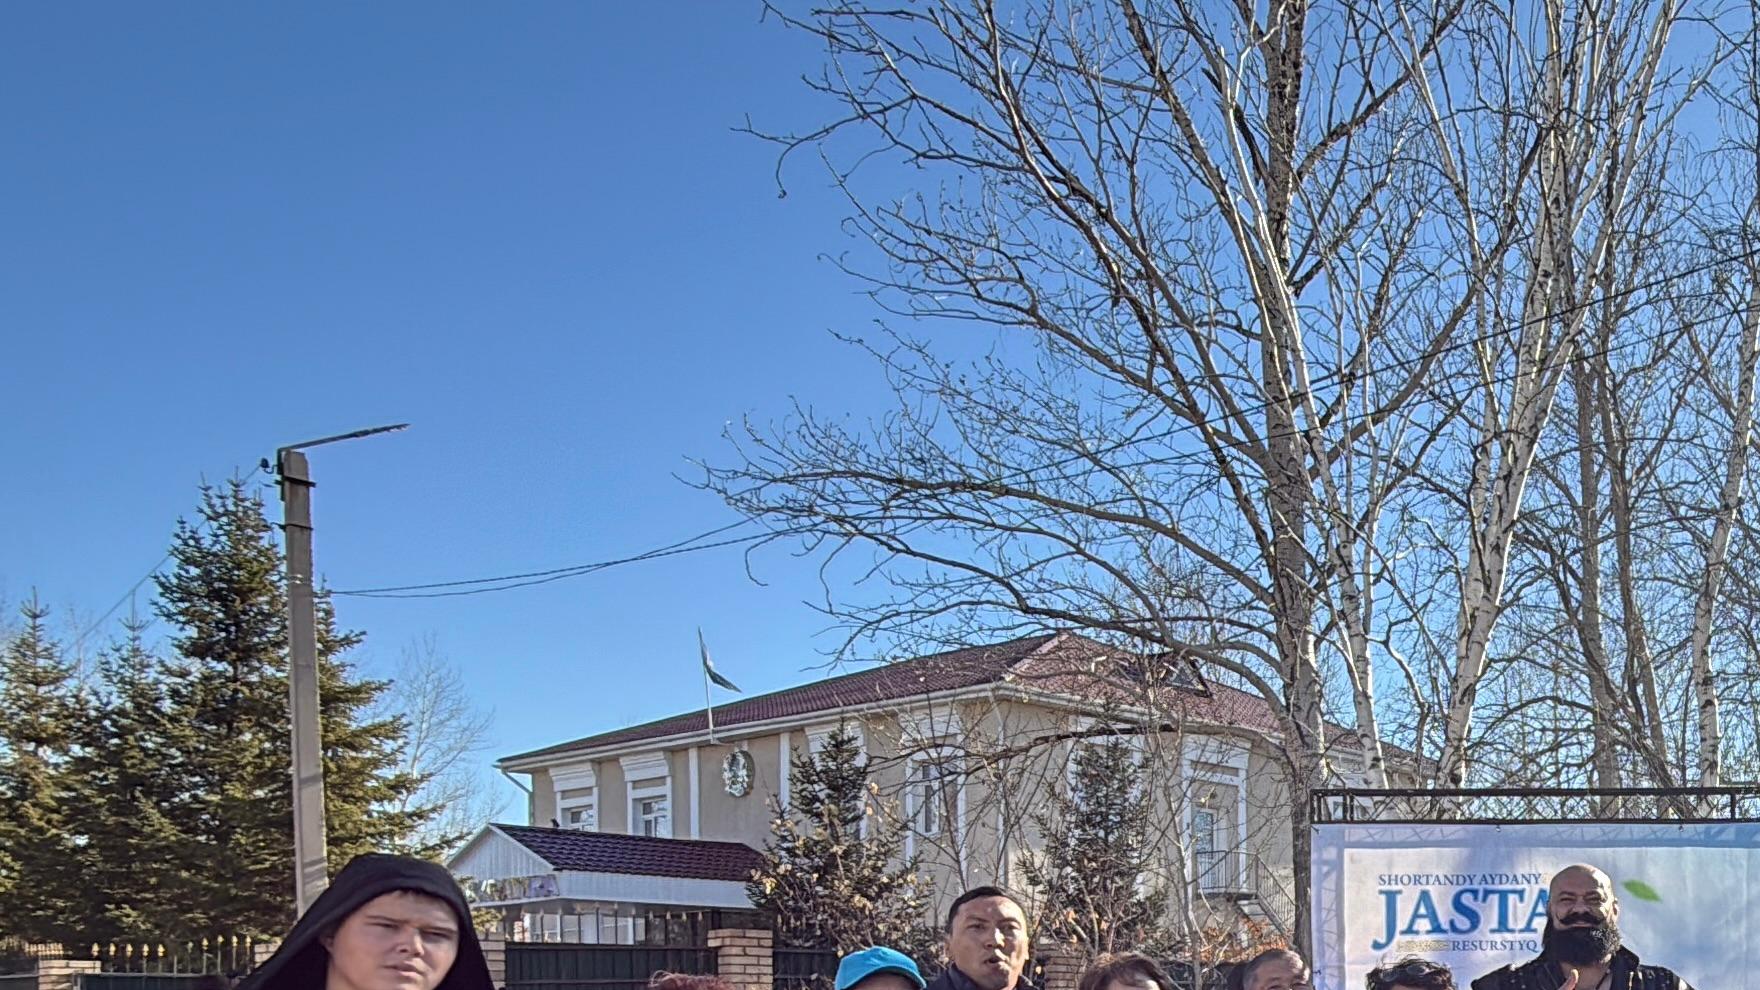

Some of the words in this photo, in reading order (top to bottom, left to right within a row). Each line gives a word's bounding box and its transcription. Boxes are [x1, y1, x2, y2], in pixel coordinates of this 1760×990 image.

[1378, 873, 1477, 887] SHORTANDY
[1478, 872, 1542, 886] AYDANY
[1370, 888, 1550, 951] JASTA
[1452, 939, 1538, 953] RESURSTYQ
